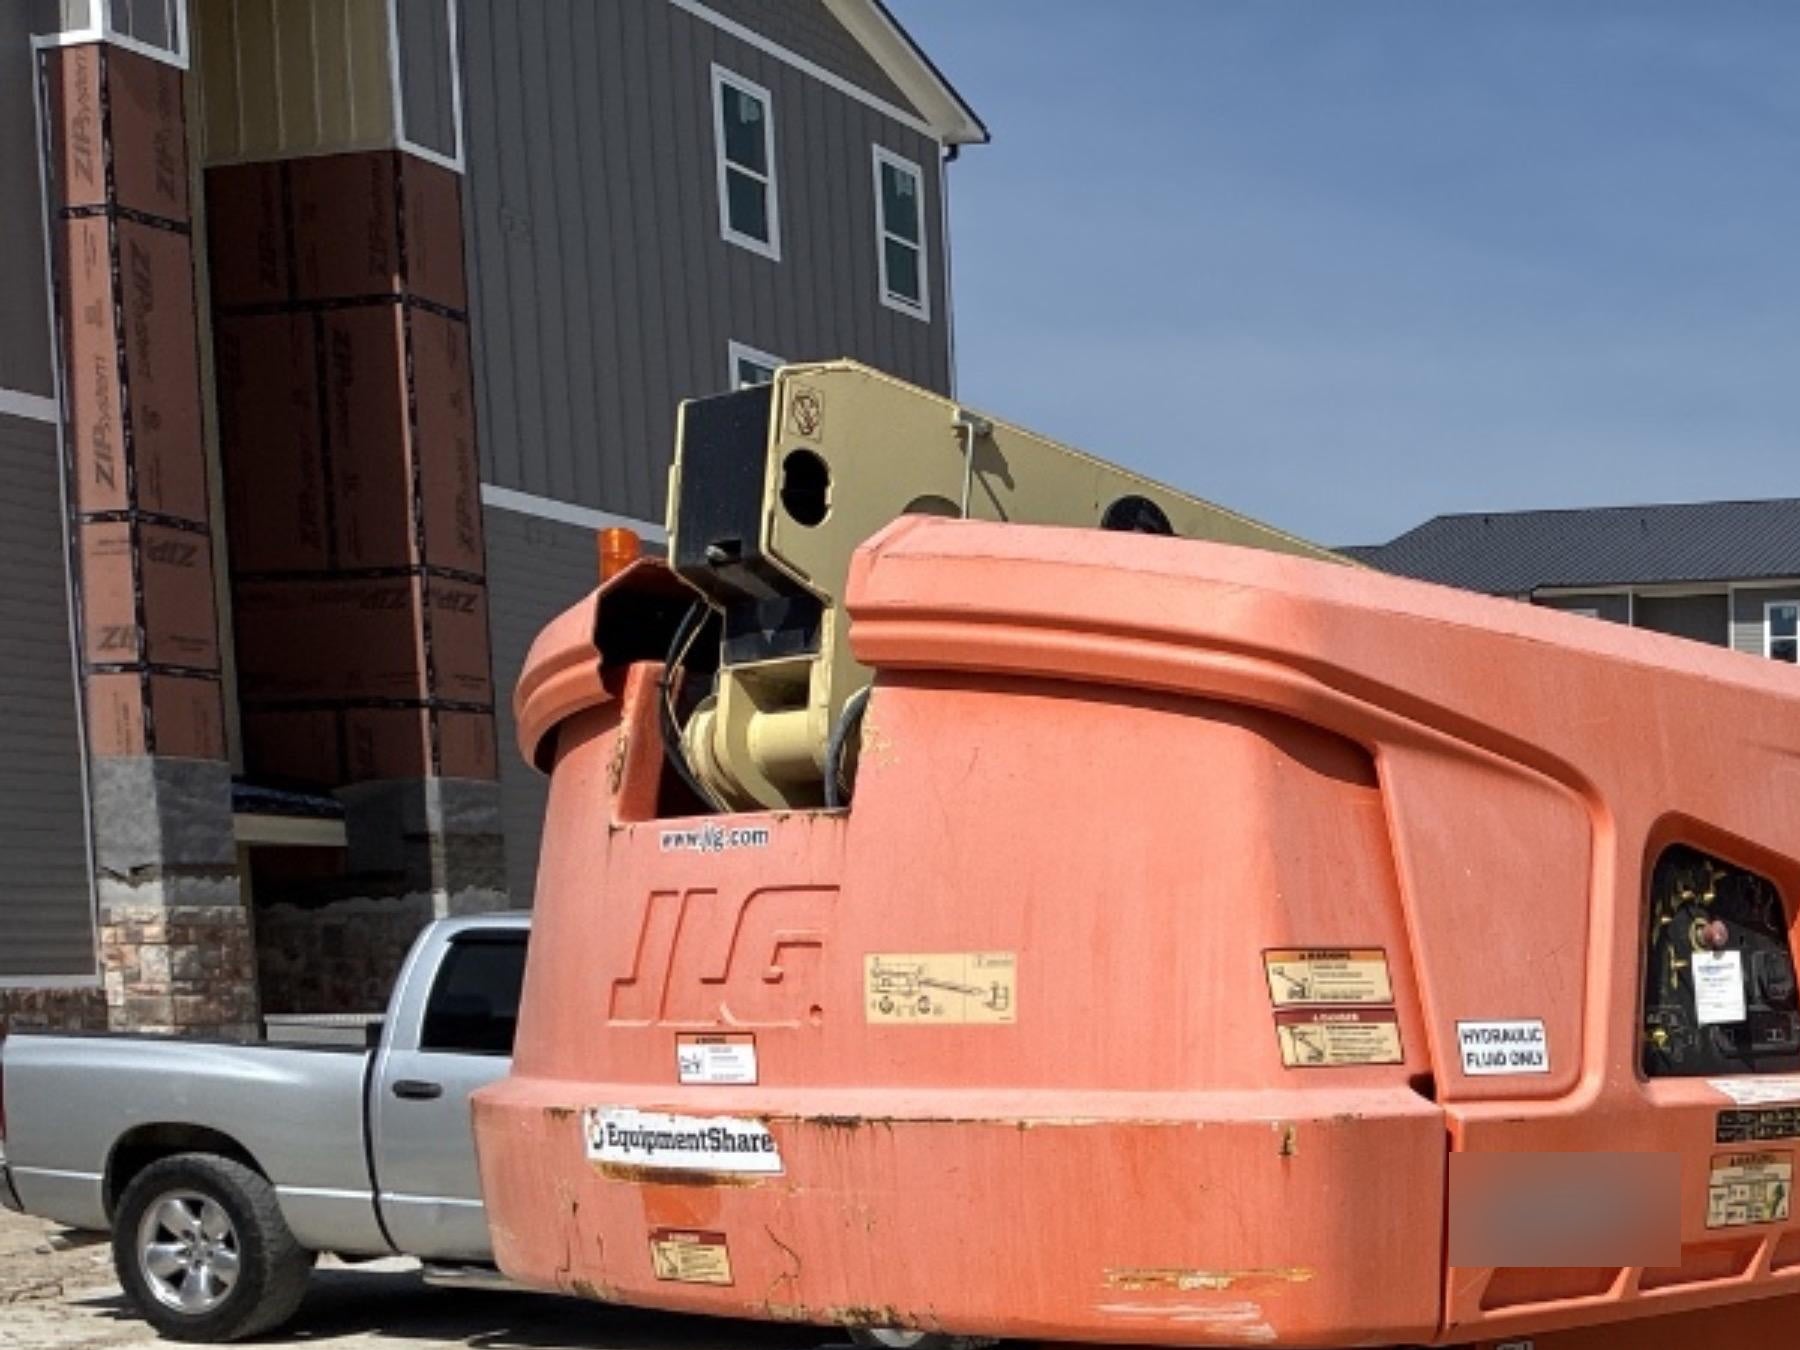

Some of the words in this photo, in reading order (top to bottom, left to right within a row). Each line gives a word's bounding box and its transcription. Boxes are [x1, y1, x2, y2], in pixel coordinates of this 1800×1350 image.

[1462, 1026, 1543, 1044] HYDRAULIC
[1466, 1050, 1507, 1068] FLUID
[1510, 1050, 1543, 1067] ONLY
[606, 1121, 775, 1154] EquipmentShare
